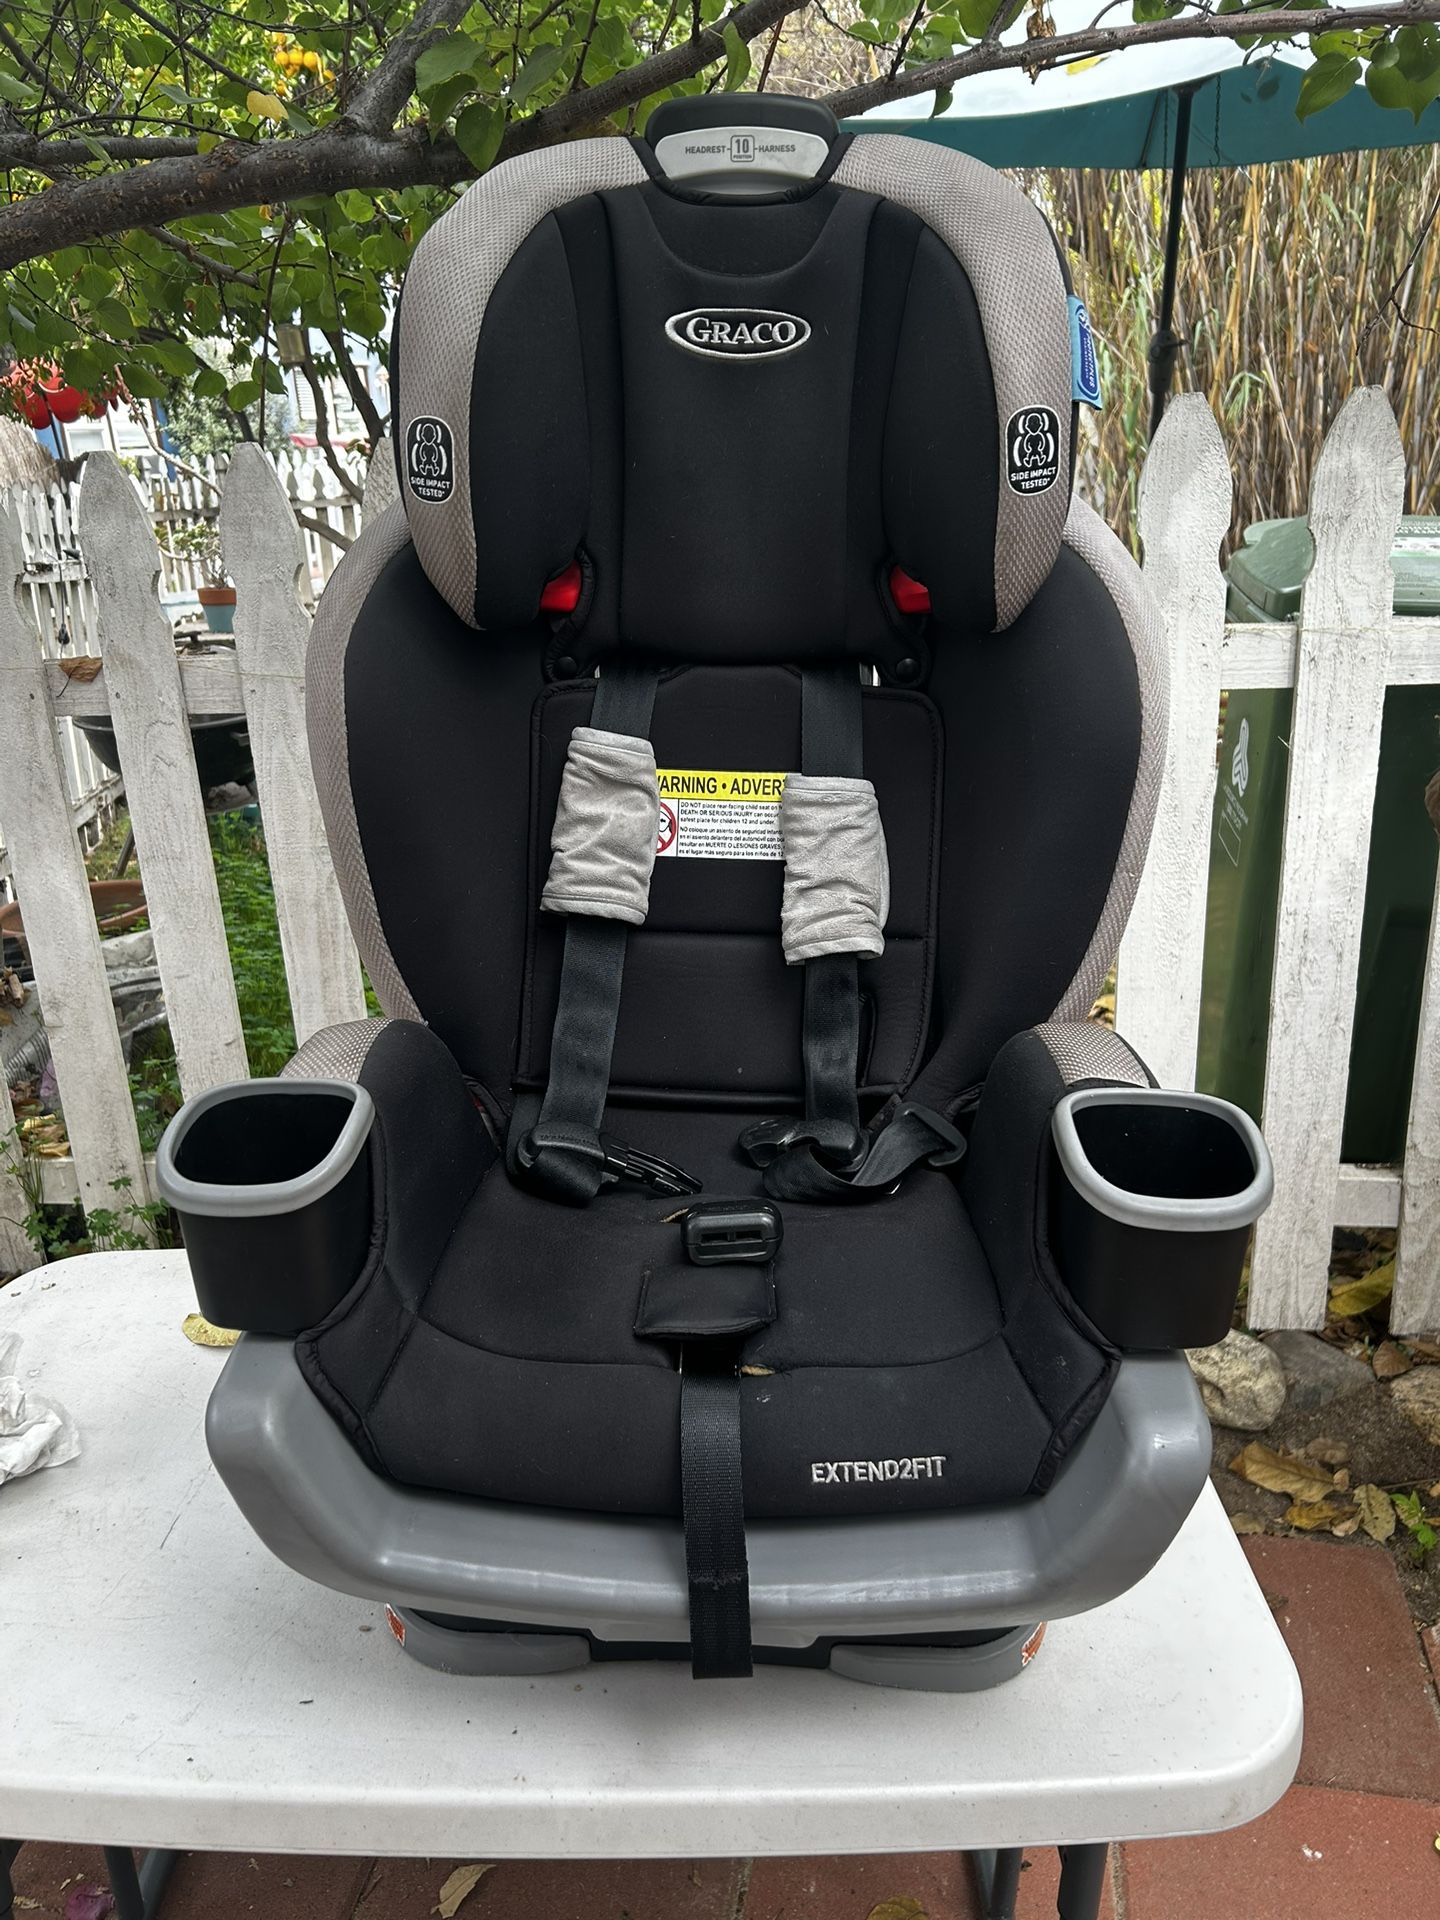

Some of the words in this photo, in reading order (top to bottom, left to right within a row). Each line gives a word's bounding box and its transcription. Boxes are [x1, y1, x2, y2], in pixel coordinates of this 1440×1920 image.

[685, 145, 726, 154] HEADREST
[735, 138, 749, 153] 10
[758, 144, 796, 153] HARNESS
[686, 317, 797, 345] GRACO
[410, 476, 425, 486] SIDE
[425, 479, 451, 489] IMPACT
[1010, 470, 1029, 482] SIDE
[1030, 466, 1057, 479] IMPACT
[730, 778, 785, 796] ADVER
[811, 1455, 947, 1484] EXTEND2FIT
